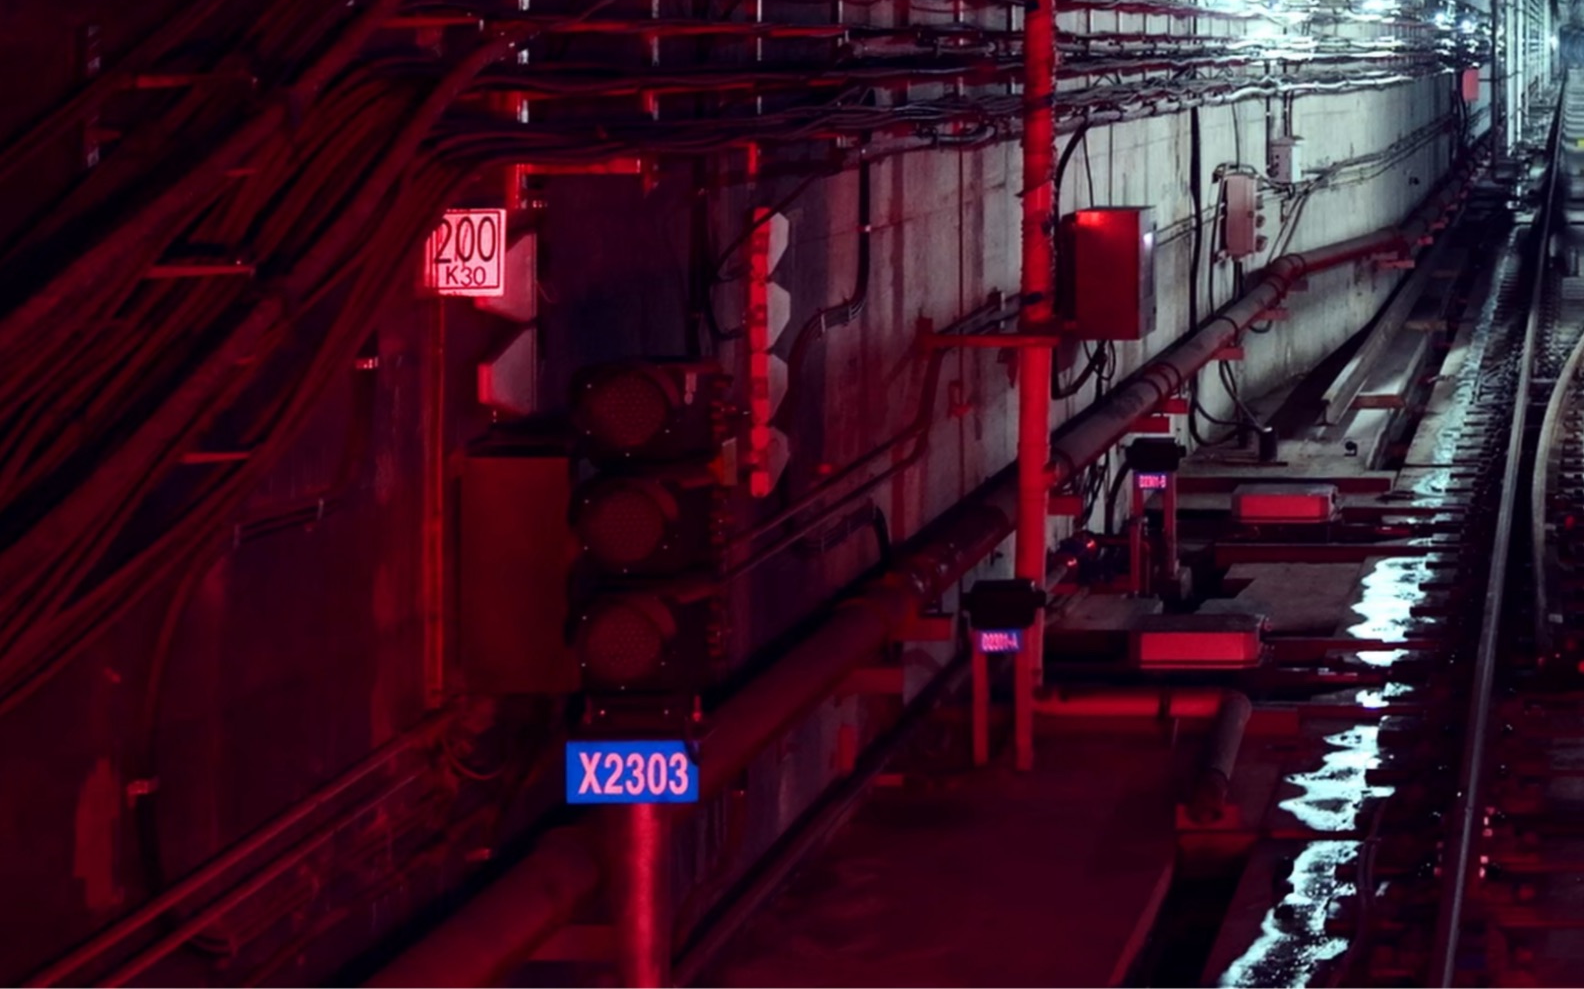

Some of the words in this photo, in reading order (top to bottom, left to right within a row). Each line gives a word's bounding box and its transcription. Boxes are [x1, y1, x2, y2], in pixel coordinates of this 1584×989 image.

[434, 216, 496, 263] 200
[446, 266, 486, 286] K30
[578, 752, 689, 795] X2303
